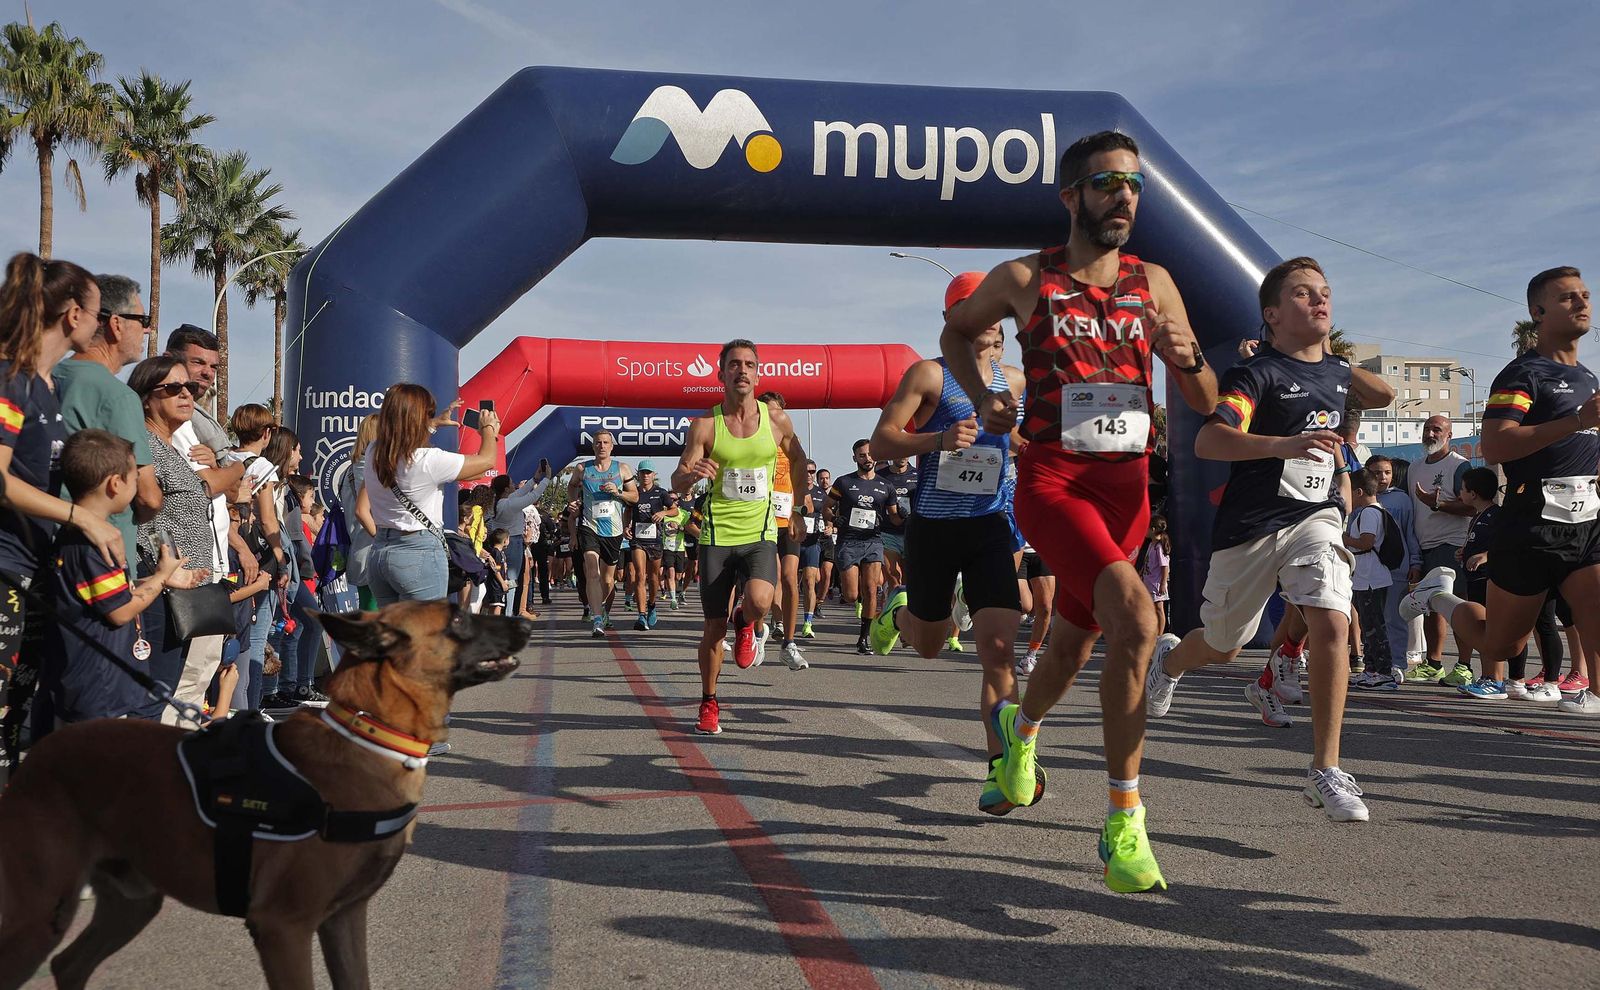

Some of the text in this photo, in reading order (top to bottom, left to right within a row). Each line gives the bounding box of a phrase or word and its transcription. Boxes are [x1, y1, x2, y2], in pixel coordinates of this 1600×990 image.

[812, 112, 1056, 201] mupol
[1052, 314, 1145, 341] KENYA
[616, 356, 683, 380] Sports
[304, 385, 390, 409] fundac
[1280, 391, 1310, 400] Santander
[320, 415, 366, 433] mu
[580, 415, 692, 430] POLICIA
[1093, 418, 1127, 435] 143
[1304, 410, 1341, 429] 200
[323, 458, 340, 490] Fundación
[958, 470, 984, 483] 474
[1303, 475, 1326, 489] 331
[738, 485, 756, 494] 149
[1570, 501, 1585, 513] 27
[413, 510, 430, 527] LOLA
